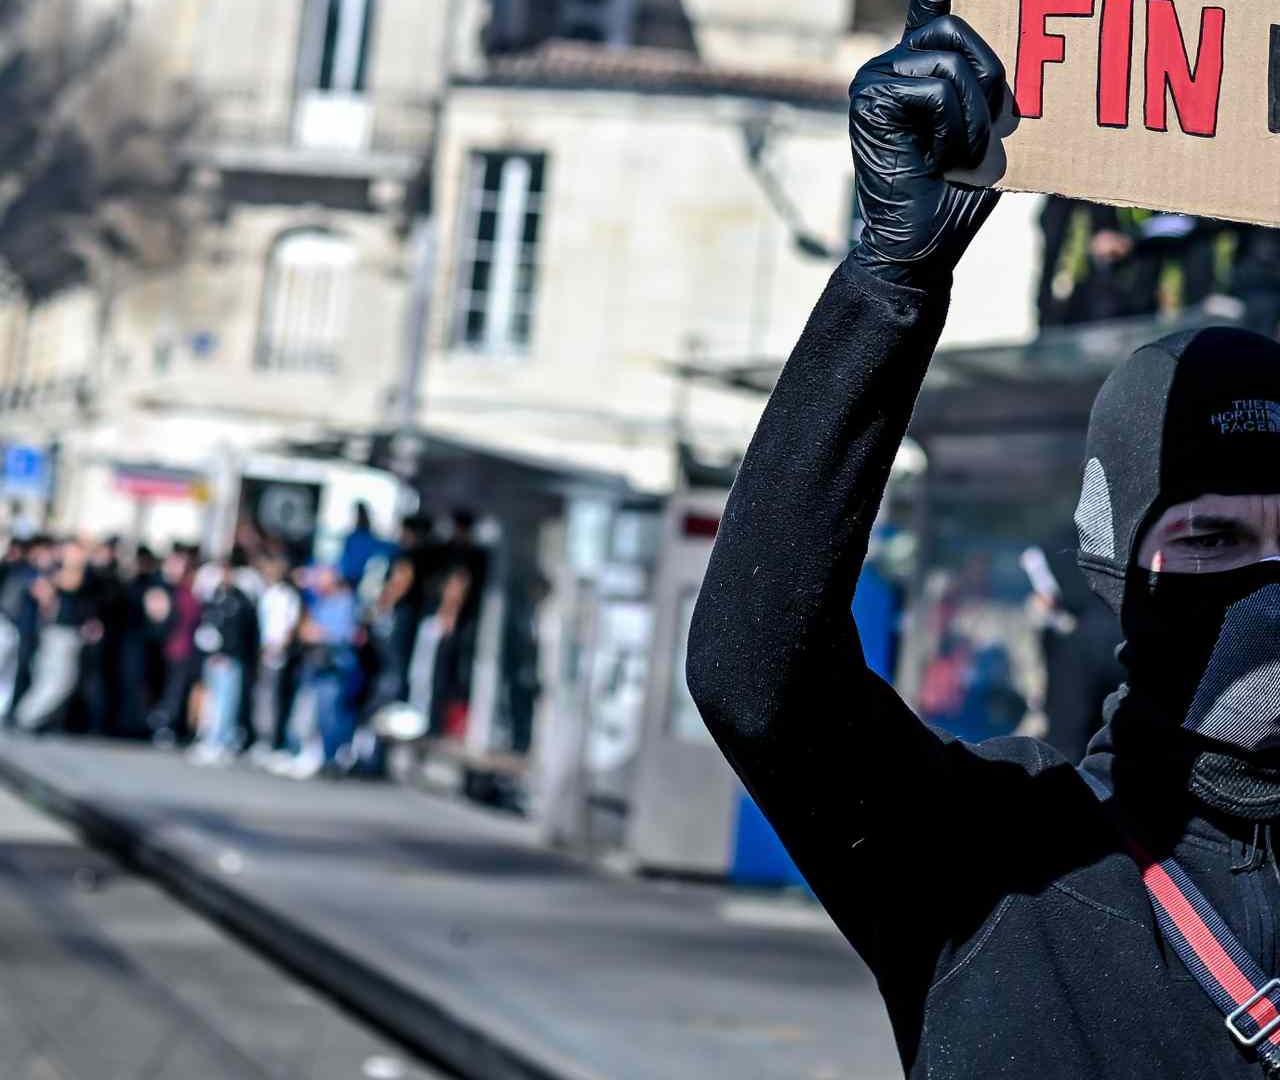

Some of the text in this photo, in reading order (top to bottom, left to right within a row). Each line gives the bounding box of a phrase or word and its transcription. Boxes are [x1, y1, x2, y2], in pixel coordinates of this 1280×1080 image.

[1232, 399, 1263, 409] THE
[1210, 408, 1266, 424] NORTH
[1221, 421, 1267, 434] FACE
